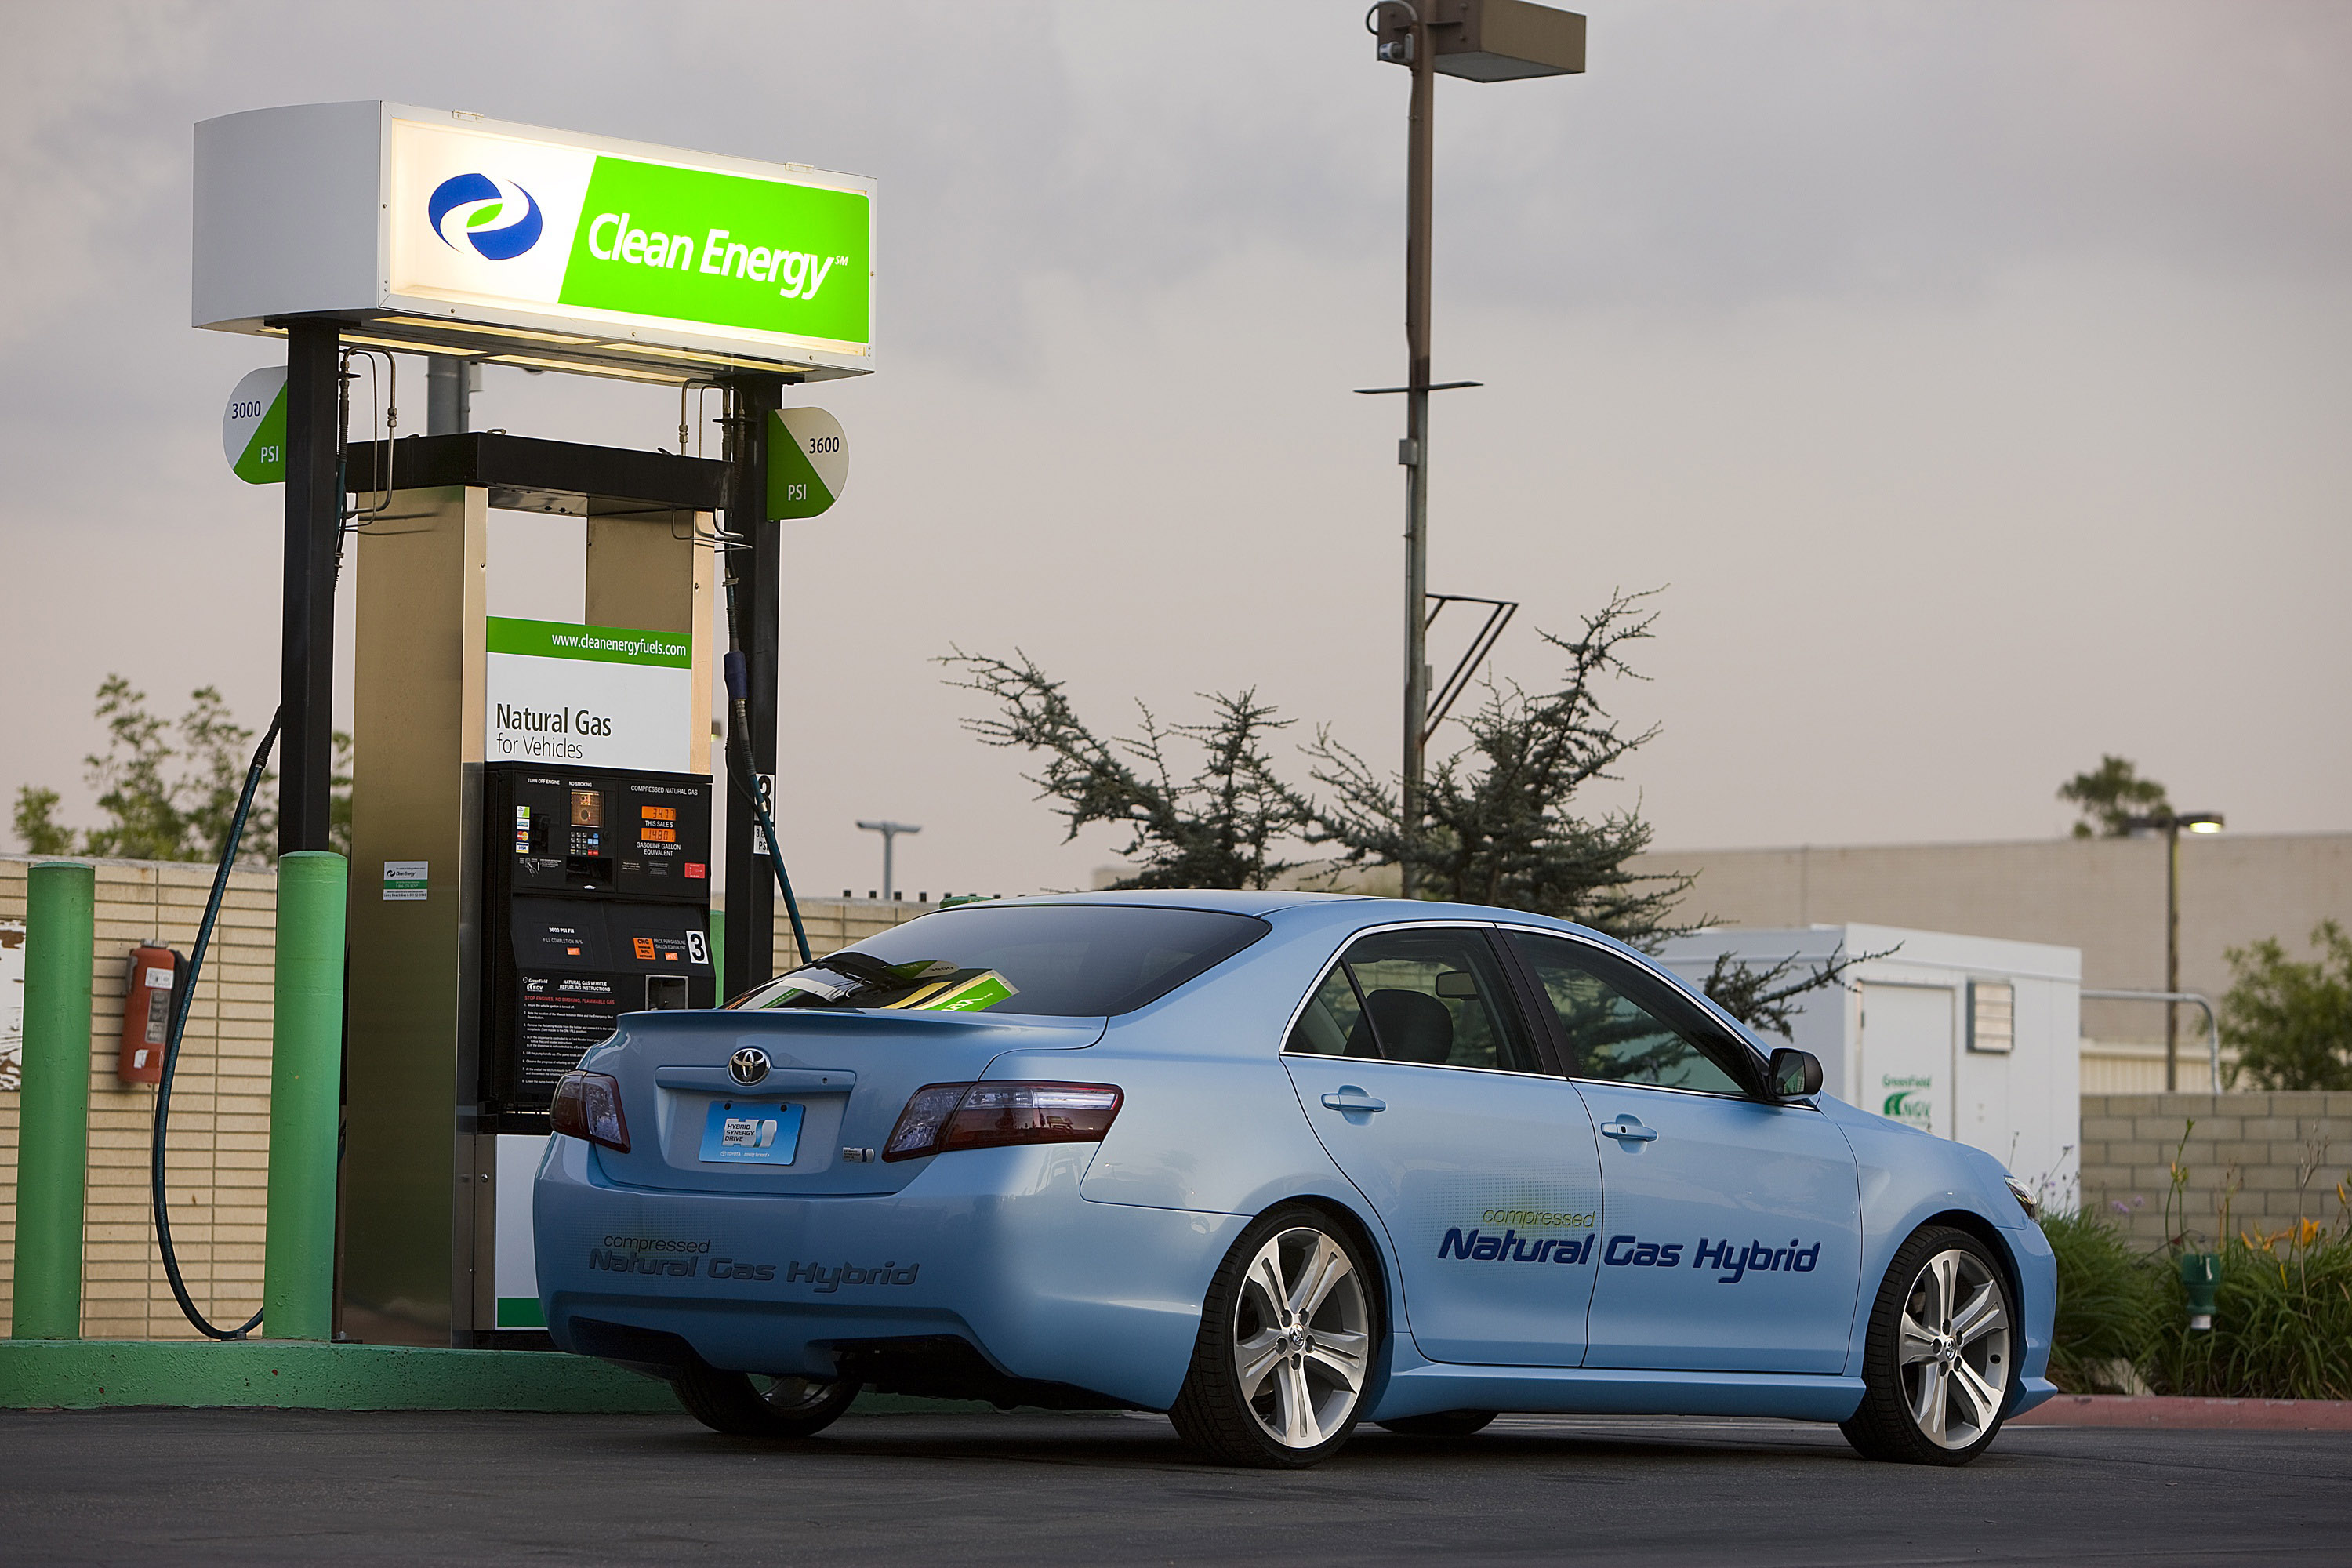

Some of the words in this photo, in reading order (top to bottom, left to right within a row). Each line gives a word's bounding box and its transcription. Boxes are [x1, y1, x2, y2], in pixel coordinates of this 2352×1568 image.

[589, 213, 694, 270] Clean
[699, 229, 834, 300] Energy
[232, 401, 260, 419] 3000
[261, 445, 279, 463] PSI
[809, 437, 839, 453] 3600
[788, 484, 806, 500] PSI
[552, 634, 686, 656] www.cleanenergyfuels.com
[497, 703, 568, 733] Natural
[575, 710, 612, 737] Gas
[497, 732, 517, 754] for
[523, 735, 583, 759] Vehicles
[652, 808, 675, 819] 34.77
[690, 933, 705, 961] 3
[1483, 1209, 1595, 1229] compressed
[604, 1236, 710, 1254] compressed
[1438, 1228, 1595, 1265] Natural
[1603, 1236, 1684, 1267] Gas
[1693, 1237, 1821, 1284] Hybrid
[590, 1248, 698, 1276] Natural
[707, 1258, 776, 1281] Gas
[787, 1261, 920, 1292] Hybrid
